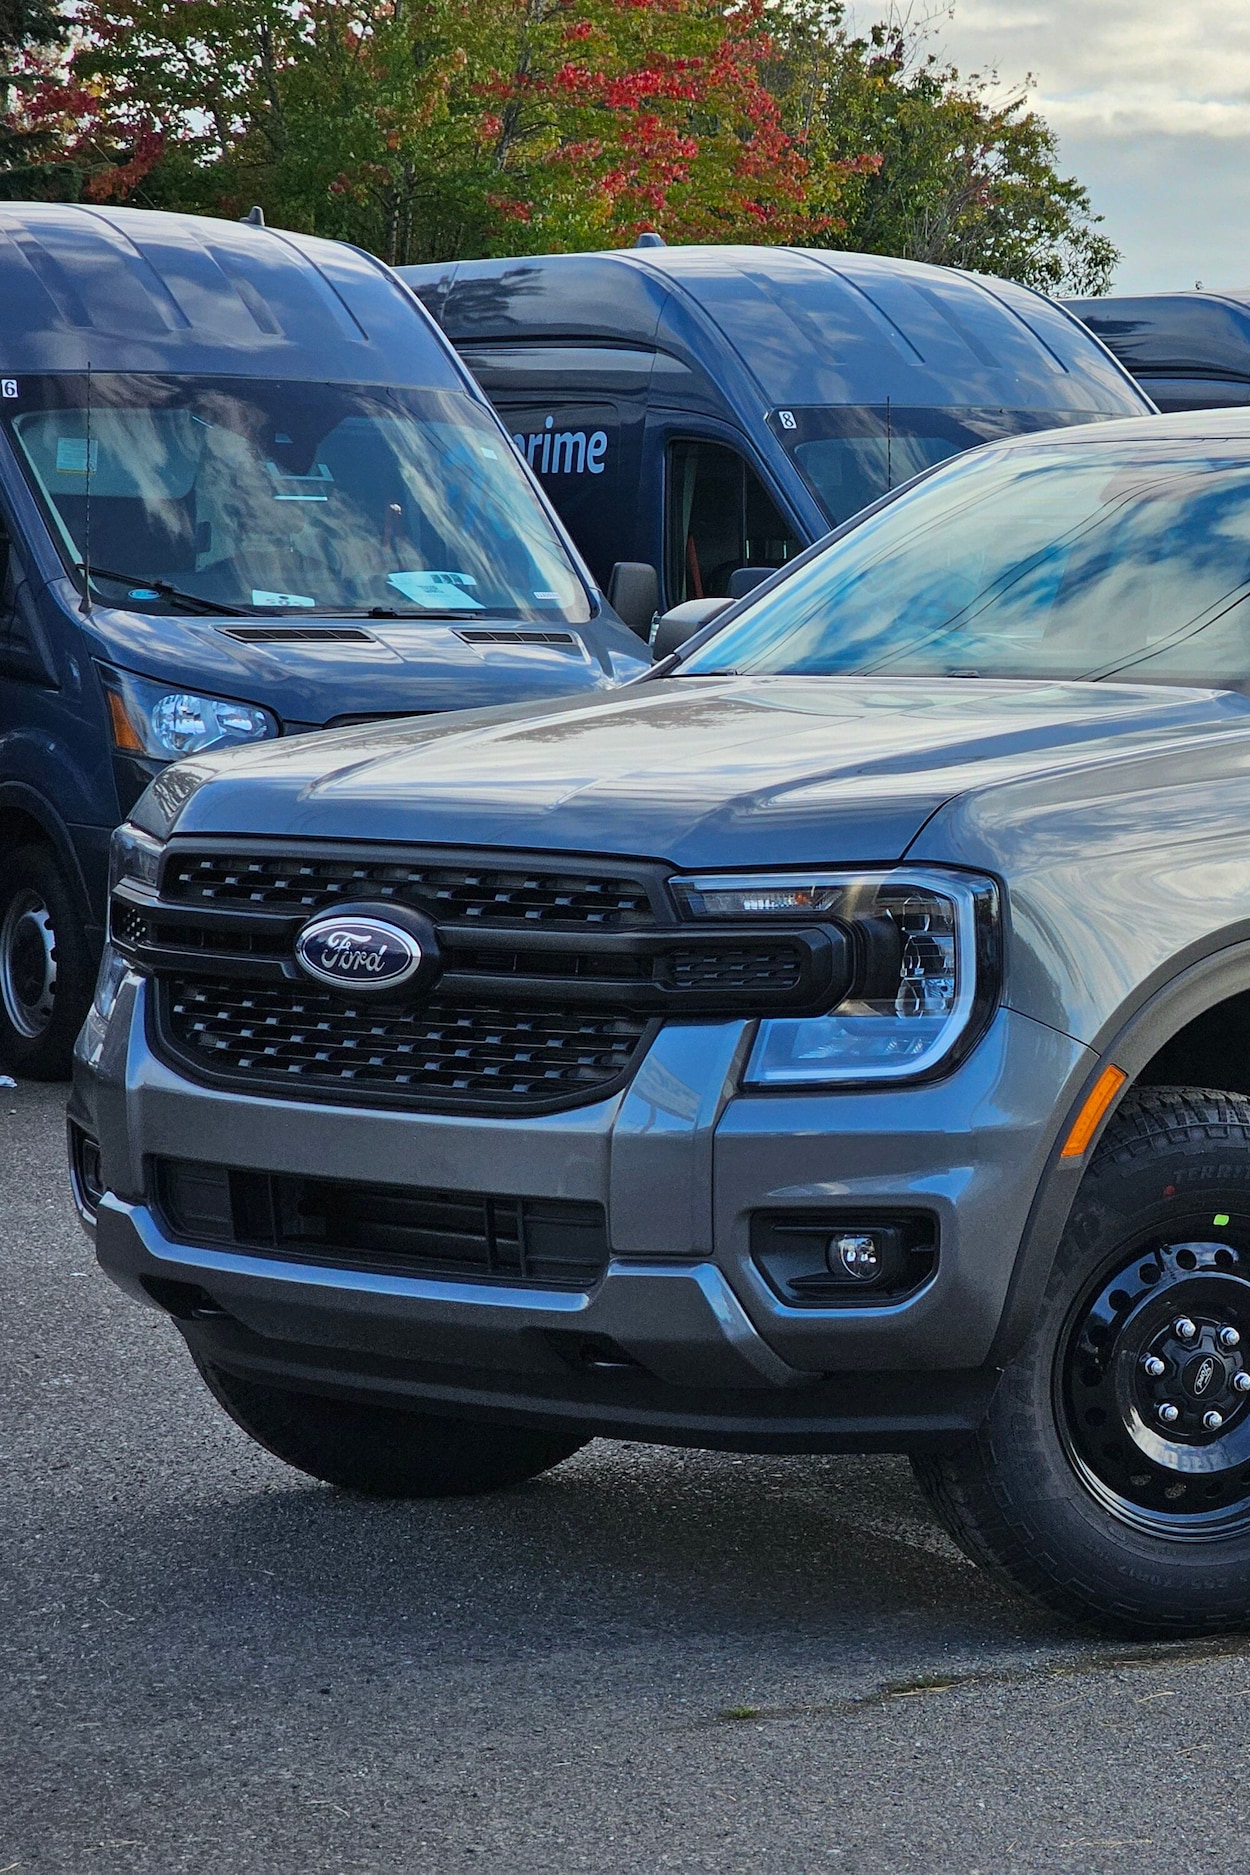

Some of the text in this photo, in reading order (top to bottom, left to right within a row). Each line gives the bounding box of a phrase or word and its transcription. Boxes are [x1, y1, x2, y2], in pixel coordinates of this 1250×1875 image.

[4, 381, 16, 397] 6
[782, 412, 794, 427] 8
[321, 931, 388, 972] Ford
